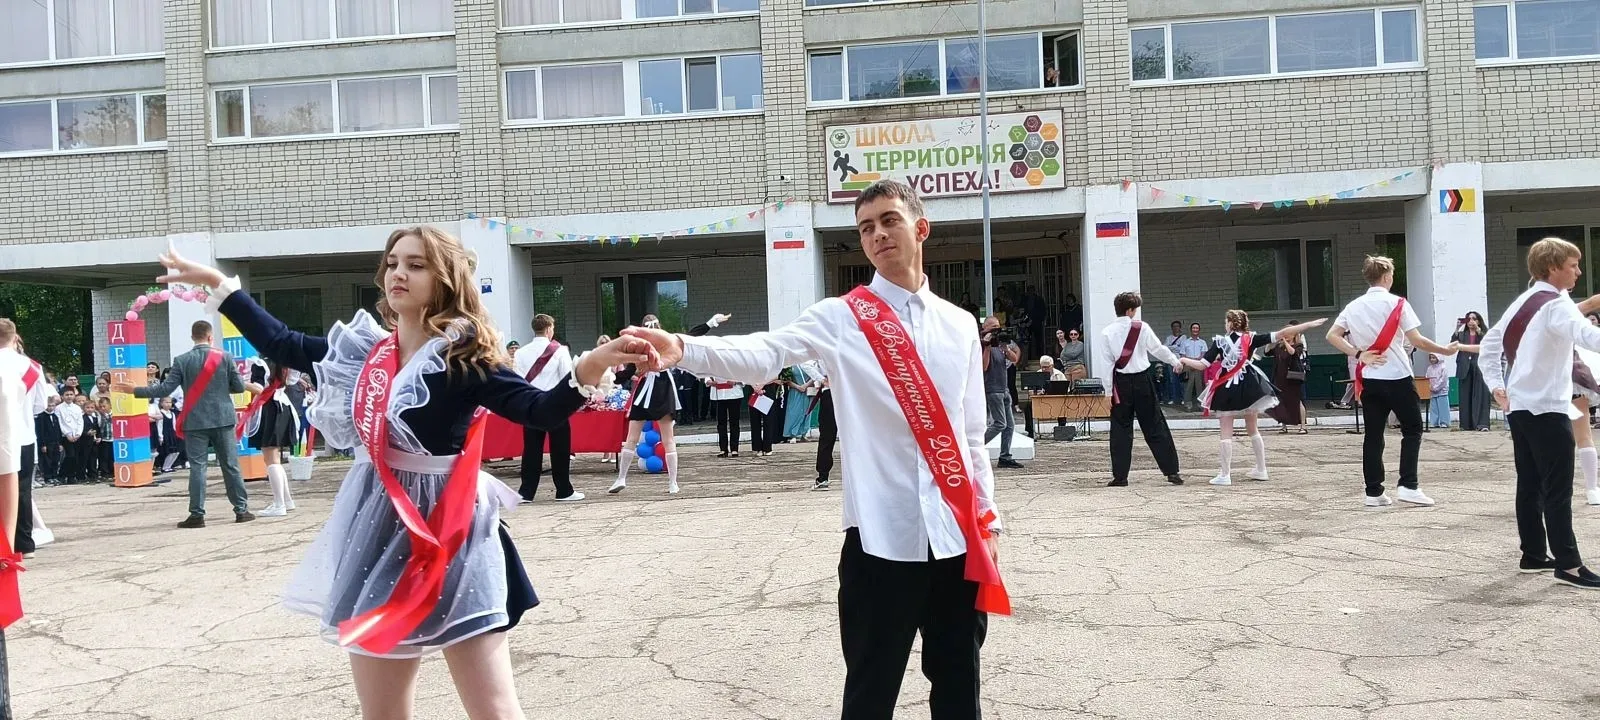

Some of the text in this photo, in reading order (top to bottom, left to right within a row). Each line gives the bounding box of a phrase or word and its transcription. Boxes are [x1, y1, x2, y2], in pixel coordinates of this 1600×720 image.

[855, 123, 936, 147] ШКОЛА
[863, 143, 1006, 172] ТЕРРИТОРИЯ
[906, 169, 1000, 194] УСПЕХА!
[874, 320, 935, 431] Выпускник
[111, 323, 131, 483] ДЕТСТВО
[928, 434, 968, 488] 2026
